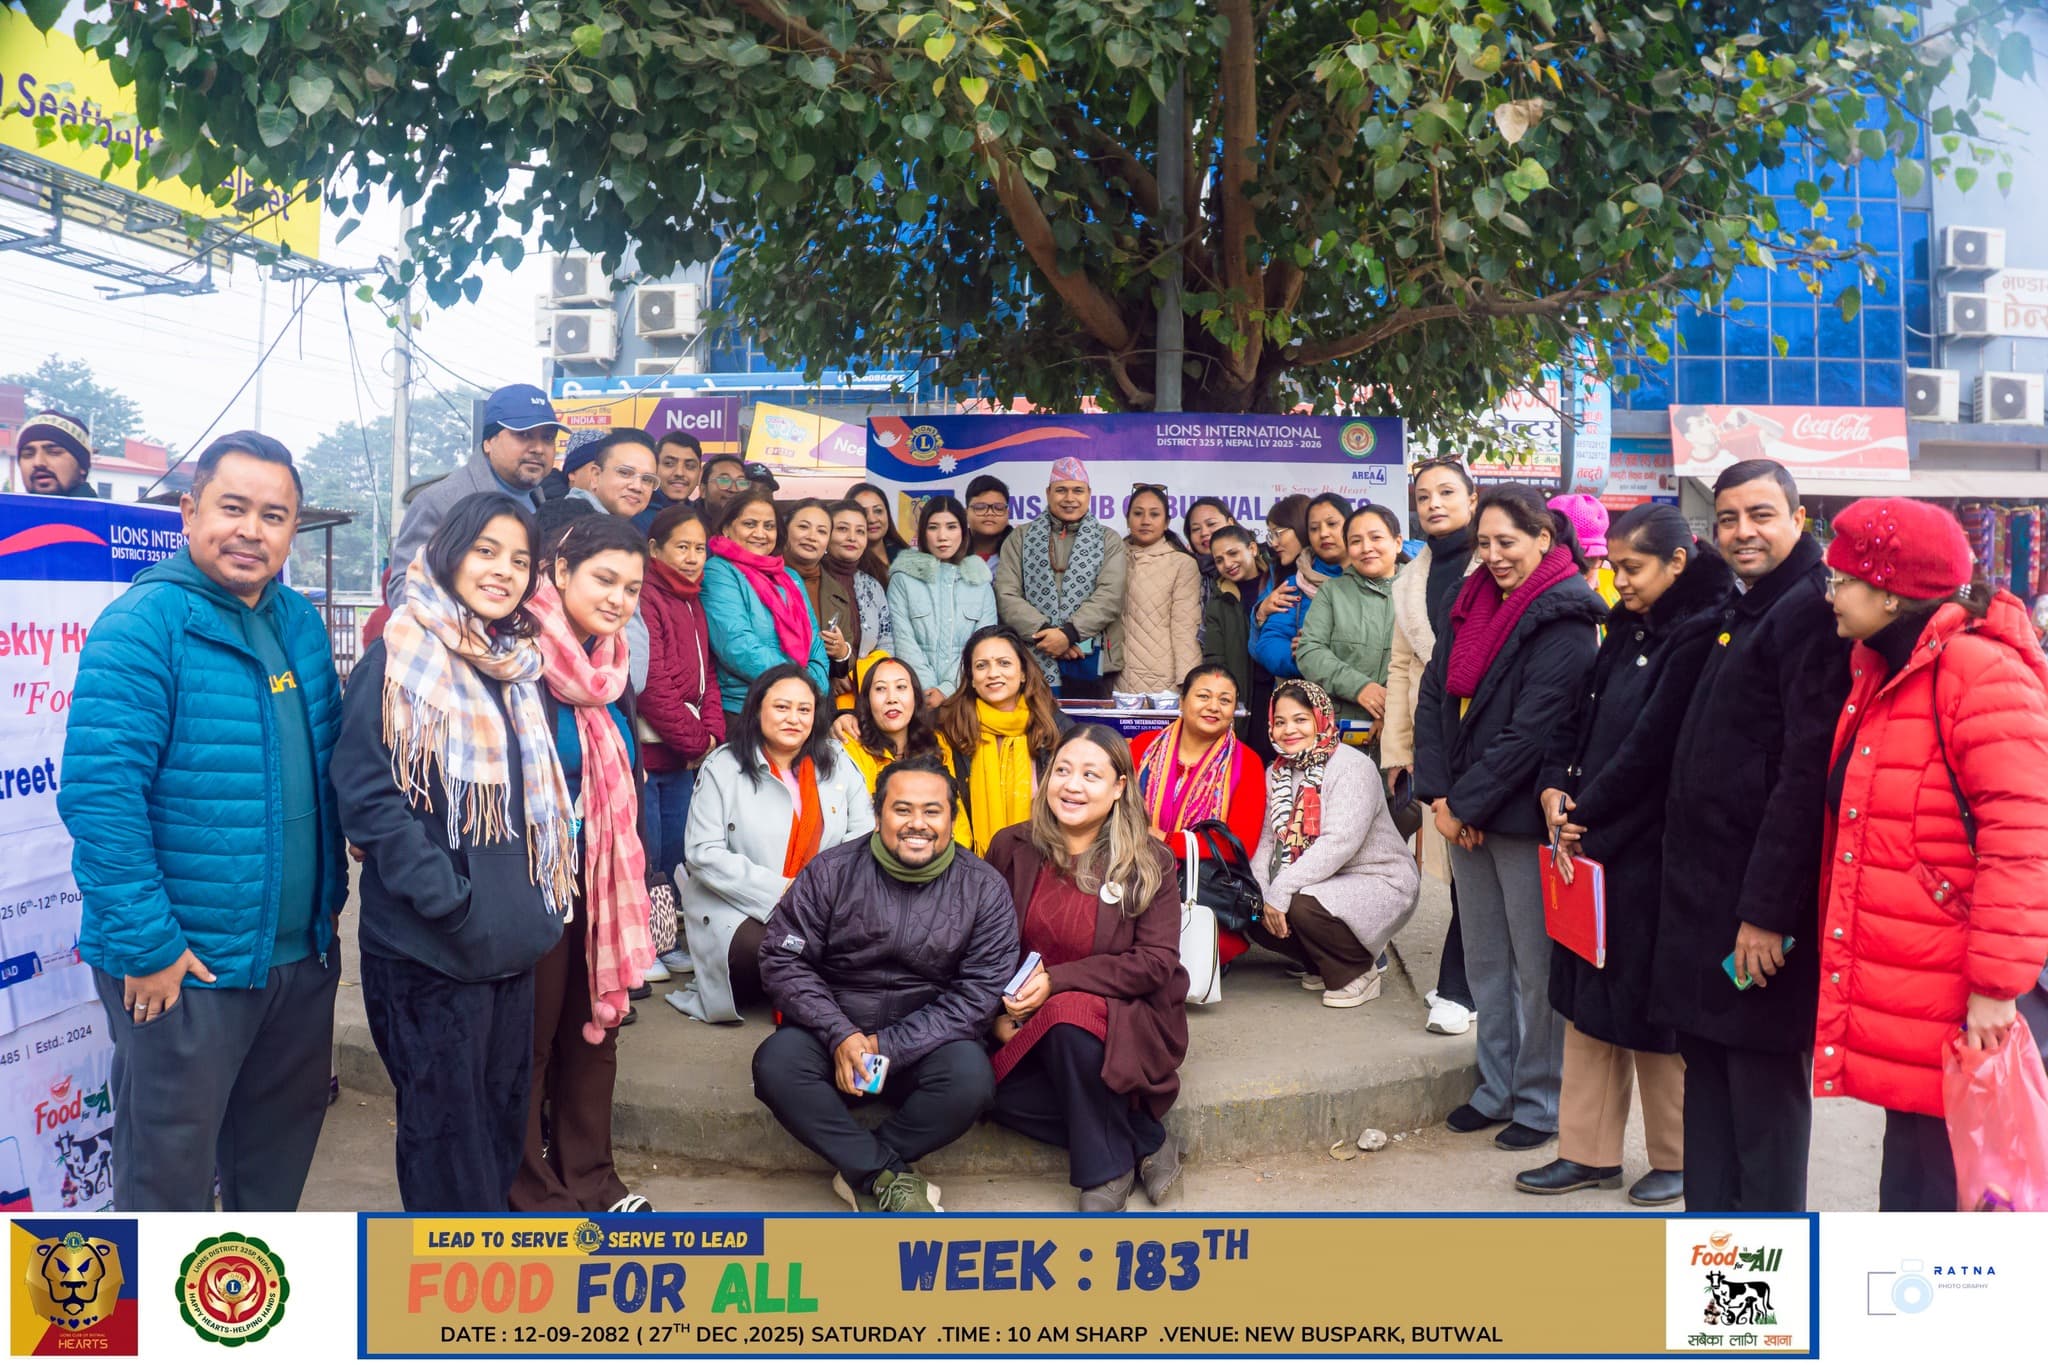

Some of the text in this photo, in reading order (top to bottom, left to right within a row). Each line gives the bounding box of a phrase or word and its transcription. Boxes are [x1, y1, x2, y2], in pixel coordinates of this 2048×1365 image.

[570, 416, 595, 425] INDIA
[666, 410, 722, 429] Ncell
[1156, 424, 1322, 439] LIONS INTERNATIONAL
[921, 436, 930, 449] L
[1157, 438, 1197, 447] DISTRICT
[1199, 439, 1215, 447] 325
[1226, 439, 1254, 447] NEPAL
[1260, 439, 1270, 447] LY
[1272, 440, 1294, 448] 2025
[1300, 440, 1322, 448] 2026
[1352, 468, 1385, 482] AREA 4
[1168, 495, 1268, 521] BUWAL
[110, 525, 149, 547] LIONS
[112, 547, 146, 561] DISTRICT
[147, 551, 160, 562] 325
[66, 1025, 92, 1043] 2024
[34, 1089, 82, 1135] Food
